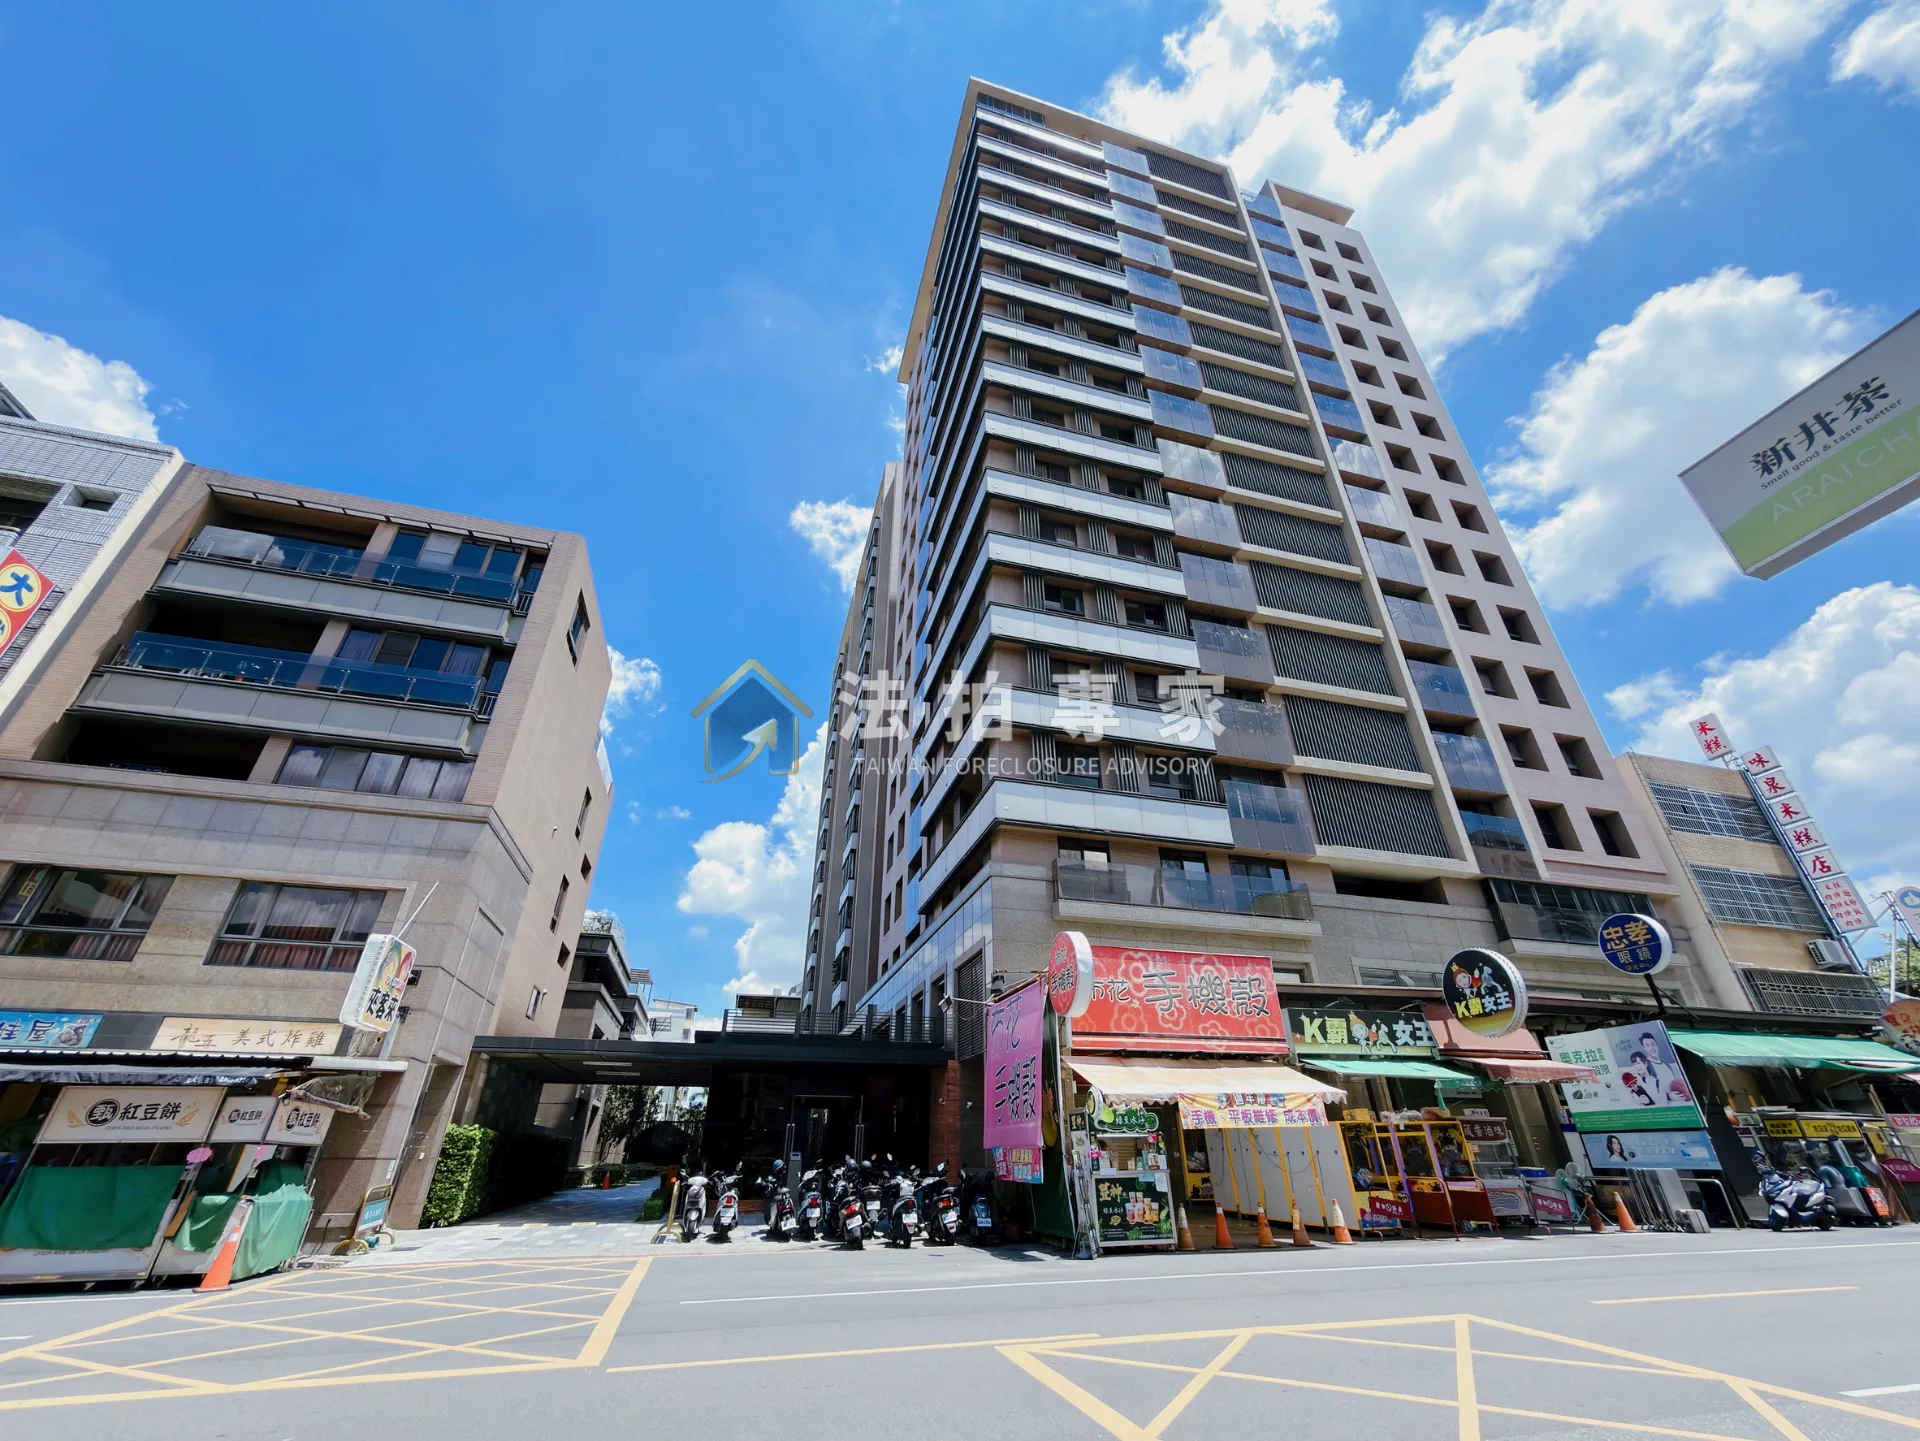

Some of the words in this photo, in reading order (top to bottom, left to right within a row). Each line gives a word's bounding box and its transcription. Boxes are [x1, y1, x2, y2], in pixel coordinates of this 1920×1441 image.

[1750, 376, 1889, 478] 新井茶
[1760, 470, 1790, 490] Smell
[1792, 451, 1820, 471] good
[1822, 443, 1832, 452] &
[1834, 424, 1863, 445] taste
[1864, 398, 1903, 425] better
[1772, 415, 1920, 524] ARAICH
[1697, 721, 1727, 755] 米糕
[1748, 752, 1832, 874] 味泉米糕店
[1602, 920, 1652, 949] 忠孝
[1617, 947, 1652, 963] 眼鏡
[1051, 964, 1074, 997] 手機殼
[1143, 971, 1270, 1016] 手機殼
[1455, 991, 1512, 1018] K霸女王
[232, 1028, 326, 1049] 美式炸雞
[1303, 1017, 1349, 1045] K霸
[1392, 1019, 1434, 1047] 女王
[1559, 1048, 1598, 1064] 奧克拉
[994, 1054, 1036, 1124] 手機殼
[119, 1102, 182, 1121] 紅豆餅
[298, 1111, 321, 1128] 紅豆餅
